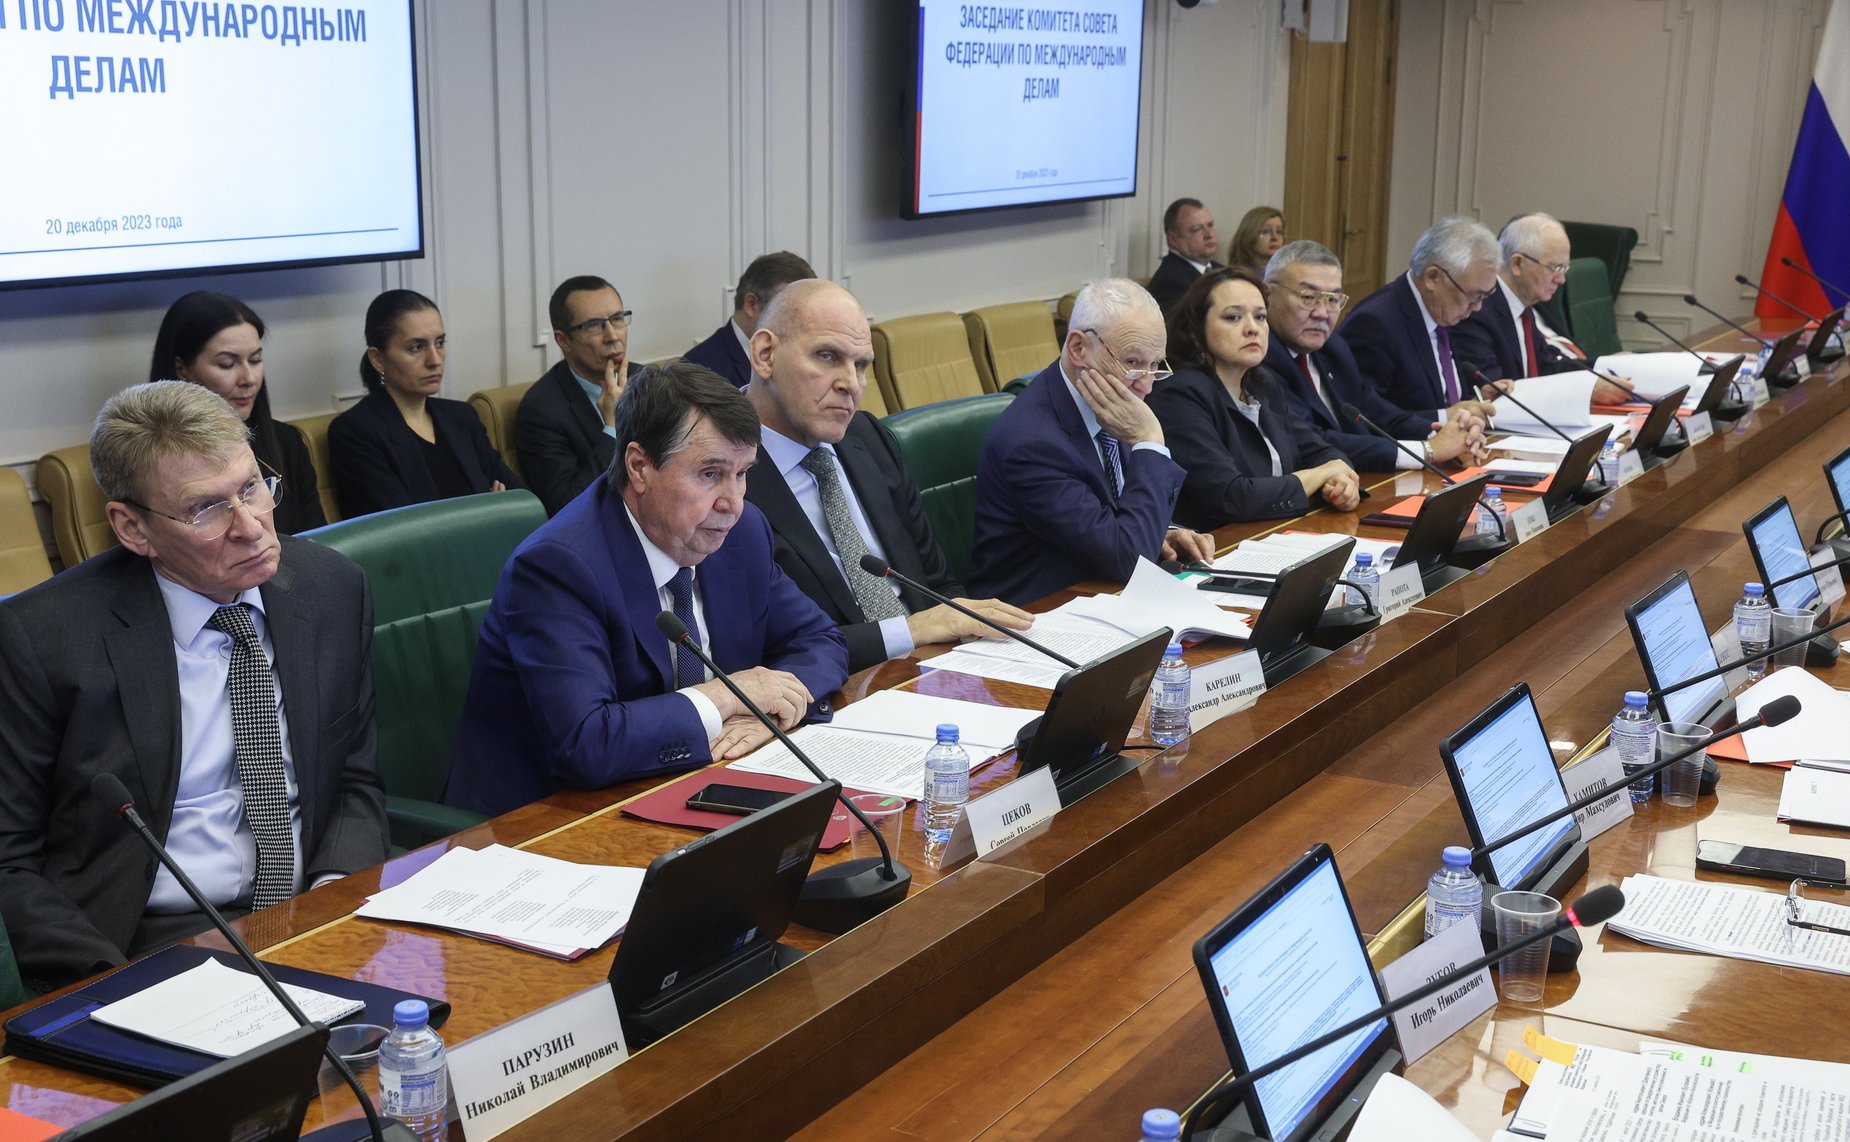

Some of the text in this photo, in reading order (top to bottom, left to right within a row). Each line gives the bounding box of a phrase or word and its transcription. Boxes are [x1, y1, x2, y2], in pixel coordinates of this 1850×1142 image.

[18, 0, 65, 32] ПО
[76, 0, 368, 46] МЕЖДУНАРОДНЫМ
[959, 5, 1118, 34] ЗАСЕДАНИЕ КОМИТЕТА СОВЕТА
[945, 41, 1127, 69] ФЕДЕРАЦИИ ПО МЕЖДУНАРОДНЫМ
[49, 54, 167, 99] ДЕЛАМ
[1022, 77, 1060, 102] ДЕЛАМ
[45, 214, 183, 237] 20 декабря 2023 года
[1205, 672, 1242, 693] КАРЕЛИН
[1220, 681, 1267, 702] Александрович
[1001, 802, 1032, 827] ЦЕКОВ
[1410, 973, 1485, 1030] Игорь Николаевич
[502, 1031, 576, 1077] ПАРУЗИН
[464, 1079, 526, 1121] Николай
[528, 1040, 620, 1090] Владимирович
